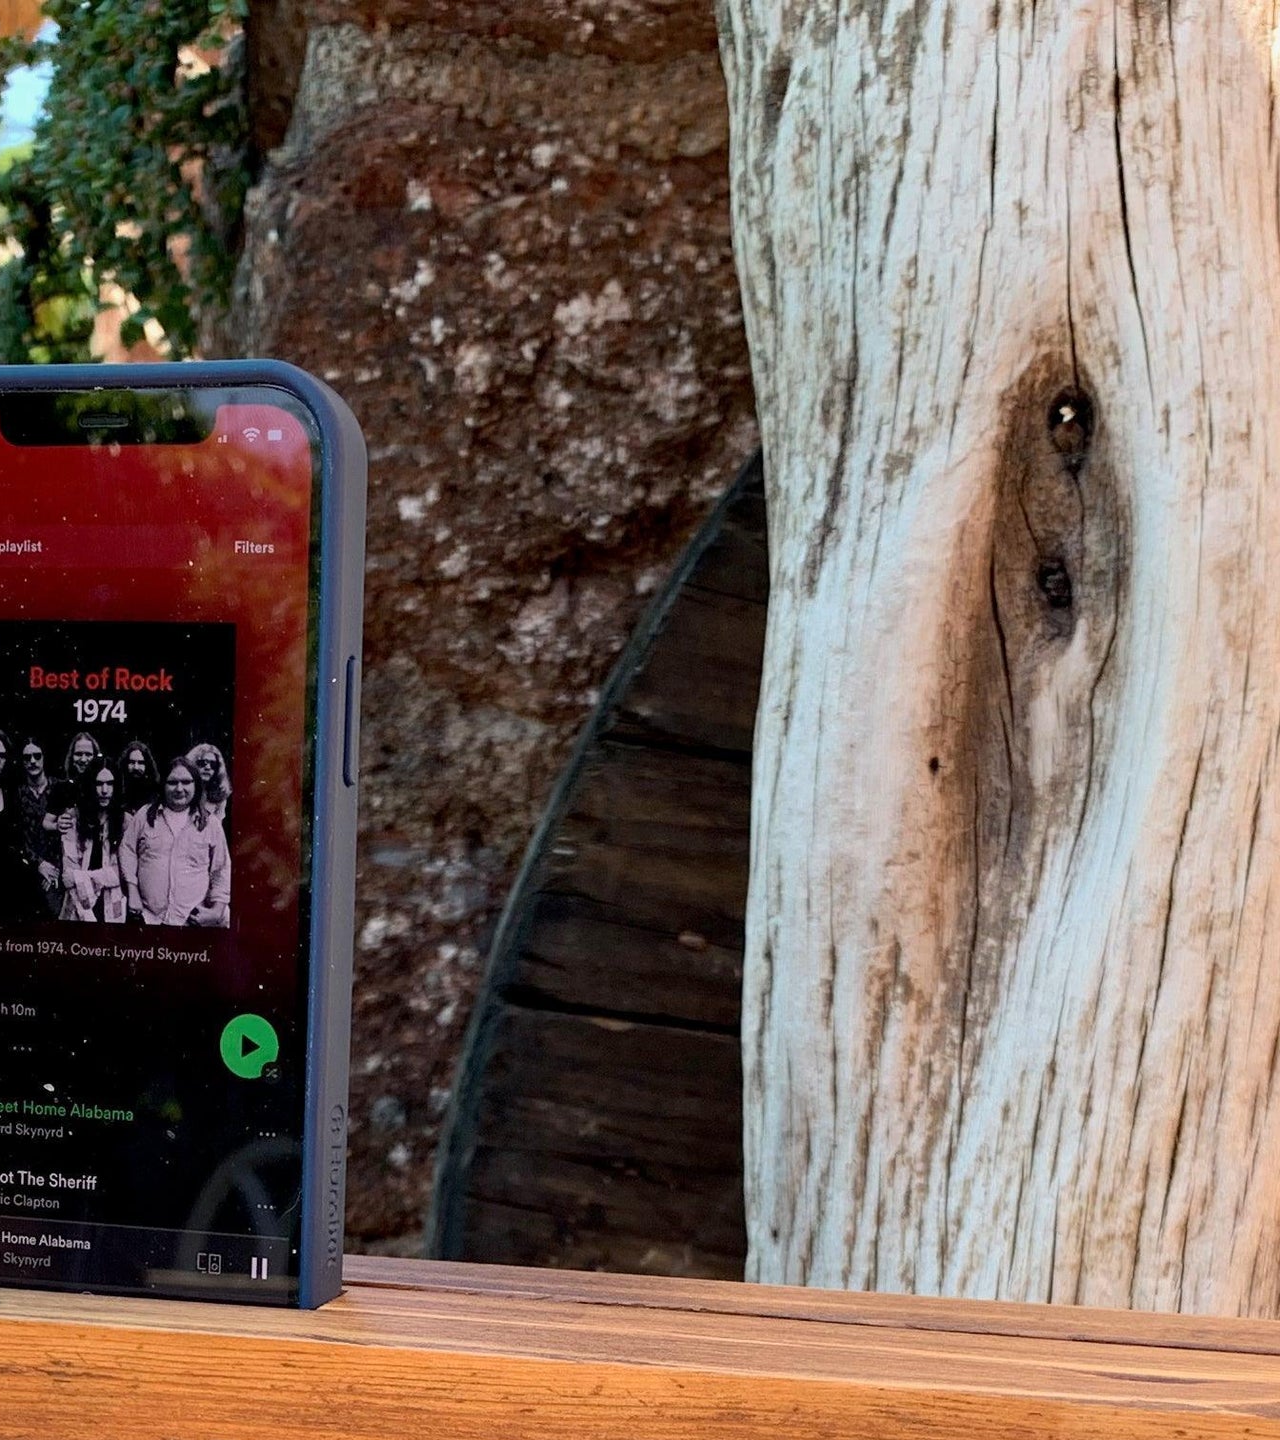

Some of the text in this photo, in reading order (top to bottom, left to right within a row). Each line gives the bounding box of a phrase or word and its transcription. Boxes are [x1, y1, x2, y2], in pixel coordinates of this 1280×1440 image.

[234, 540, 275, 555] Filters
[30, 666, 174, 692] Best of Rock
[73, 699, 127, 723] 1974
[6, 940, 34, 953] from
[36, 941, 68, 955] 1974.
[70, 943, 111, 957] Cover:
[114, 945, 154, 961] Lynyrd
[157, 947, 211, 965] Skynyrd.
[11, 1004, 36, 1017] 10m
[23, 1100, 67, 1117] Home
[70, 1103, 135, 1122] Alabama
[15, 1123, 64, 1139] Skynyrd
[17, 1170, 45, 1187] The
[48, 1172, 98, 1191] Sheriff
[13, 1194, 60, 1210] Clapton
[1, 1231, 37, 1246] Home
[39, 1234, 91, 1250] Alabama
[2, 1251, 52, 1268] Skynyrd
